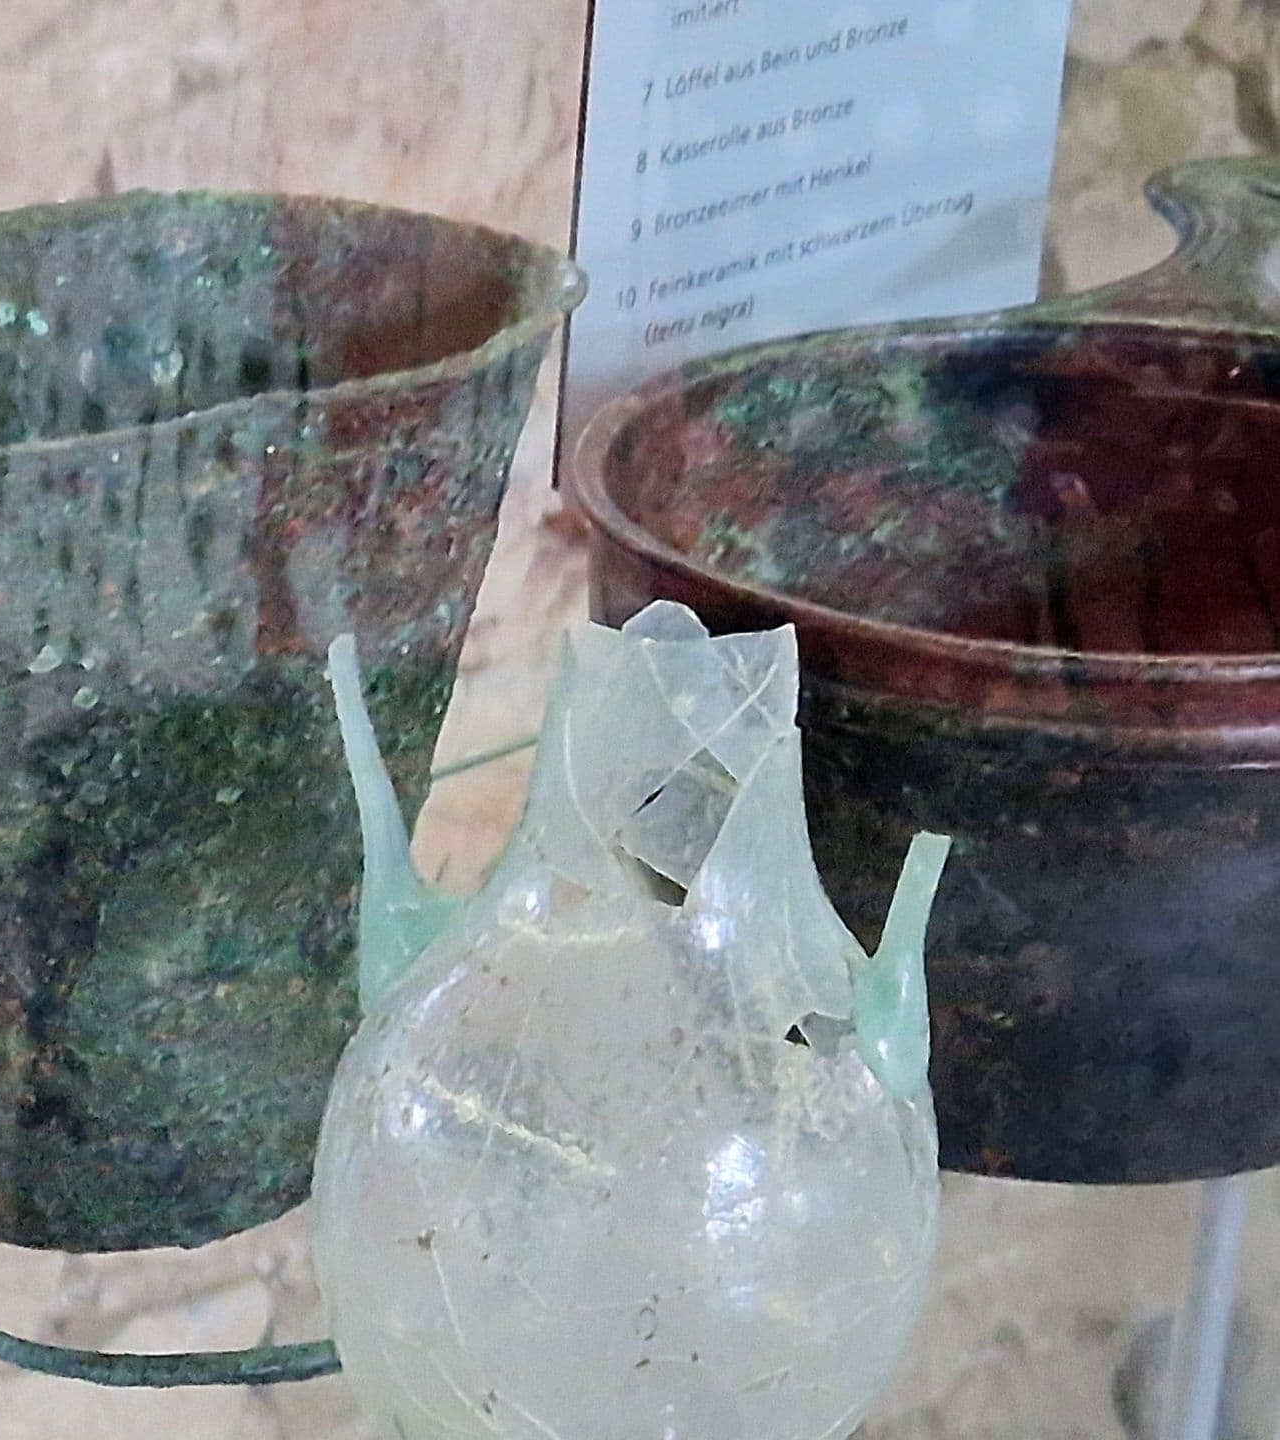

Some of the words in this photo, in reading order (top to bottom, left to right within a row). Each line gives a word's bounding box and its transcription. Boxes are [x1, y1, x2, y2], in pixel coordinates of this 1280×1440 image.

[643, 81, 653, 104] 7
[665, 64, 719, 99] Löffel
[724, 60, 754, 84] aus
[761, 47, 800, 73] Bein
[806, 33, 840, 61] und
[846, 17, 908, 49] Bronze
[636, 151, 647, 174] 8
[660, 123, 751, 165] Kasserolle
[757, 118, 786, 142] aus
[792, 98, 854, 131] Bronze
[631, 218, 642, 243] 9
[654, 186, 770, 236] Bronzeeimer
[774, 175, 804, 199] mit
[810, 153, 872, 190] Henkel
[618, 286, 637, 310] 10
[649, 255, 758, 303] Feinkeramik
[765, 242, 794, 265] mit
[800, 214, 897, 257] schwarzem
[902, 192, 974, 227] Überzug
[644, 317, 695, 349] (terra
[700, 294, 755, 331] nigra)
